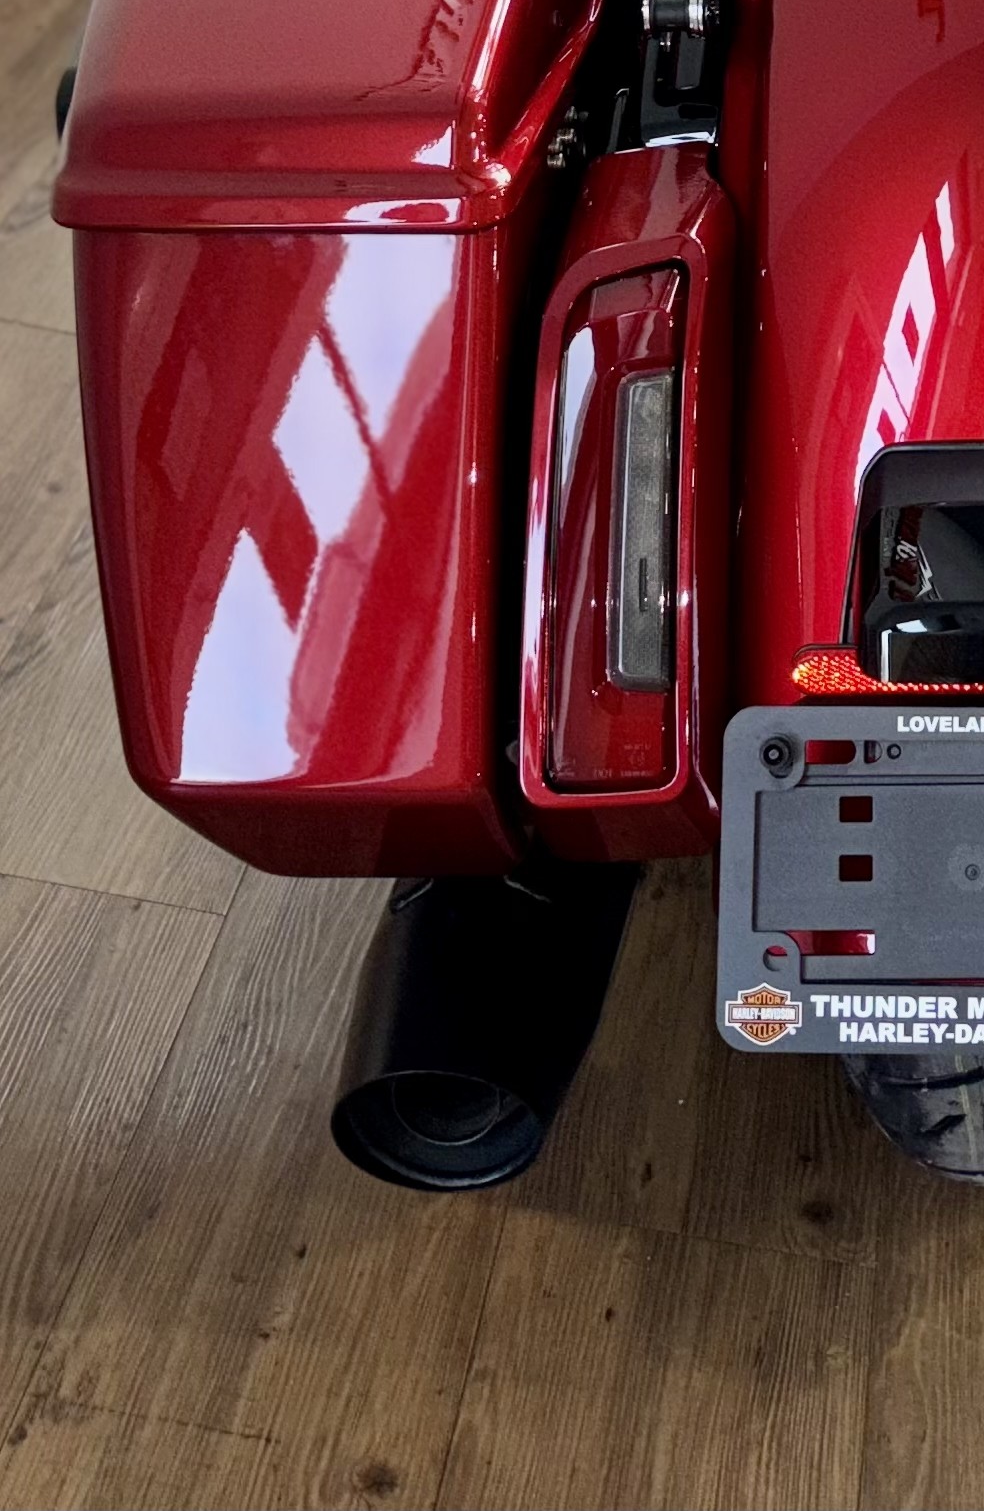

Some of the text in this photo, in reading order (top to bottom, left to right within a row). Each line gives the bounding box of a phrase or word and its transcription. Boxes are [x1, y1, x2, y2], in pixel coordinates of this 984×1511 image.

[747, 992, 781, 1004] MOTOR
[732, 1007, 796, 1020] HARLEY-DAVIDSON
[810, 995, 958, 1018] THUNDER
[746, 1023, 781, 1038] CYCLES
